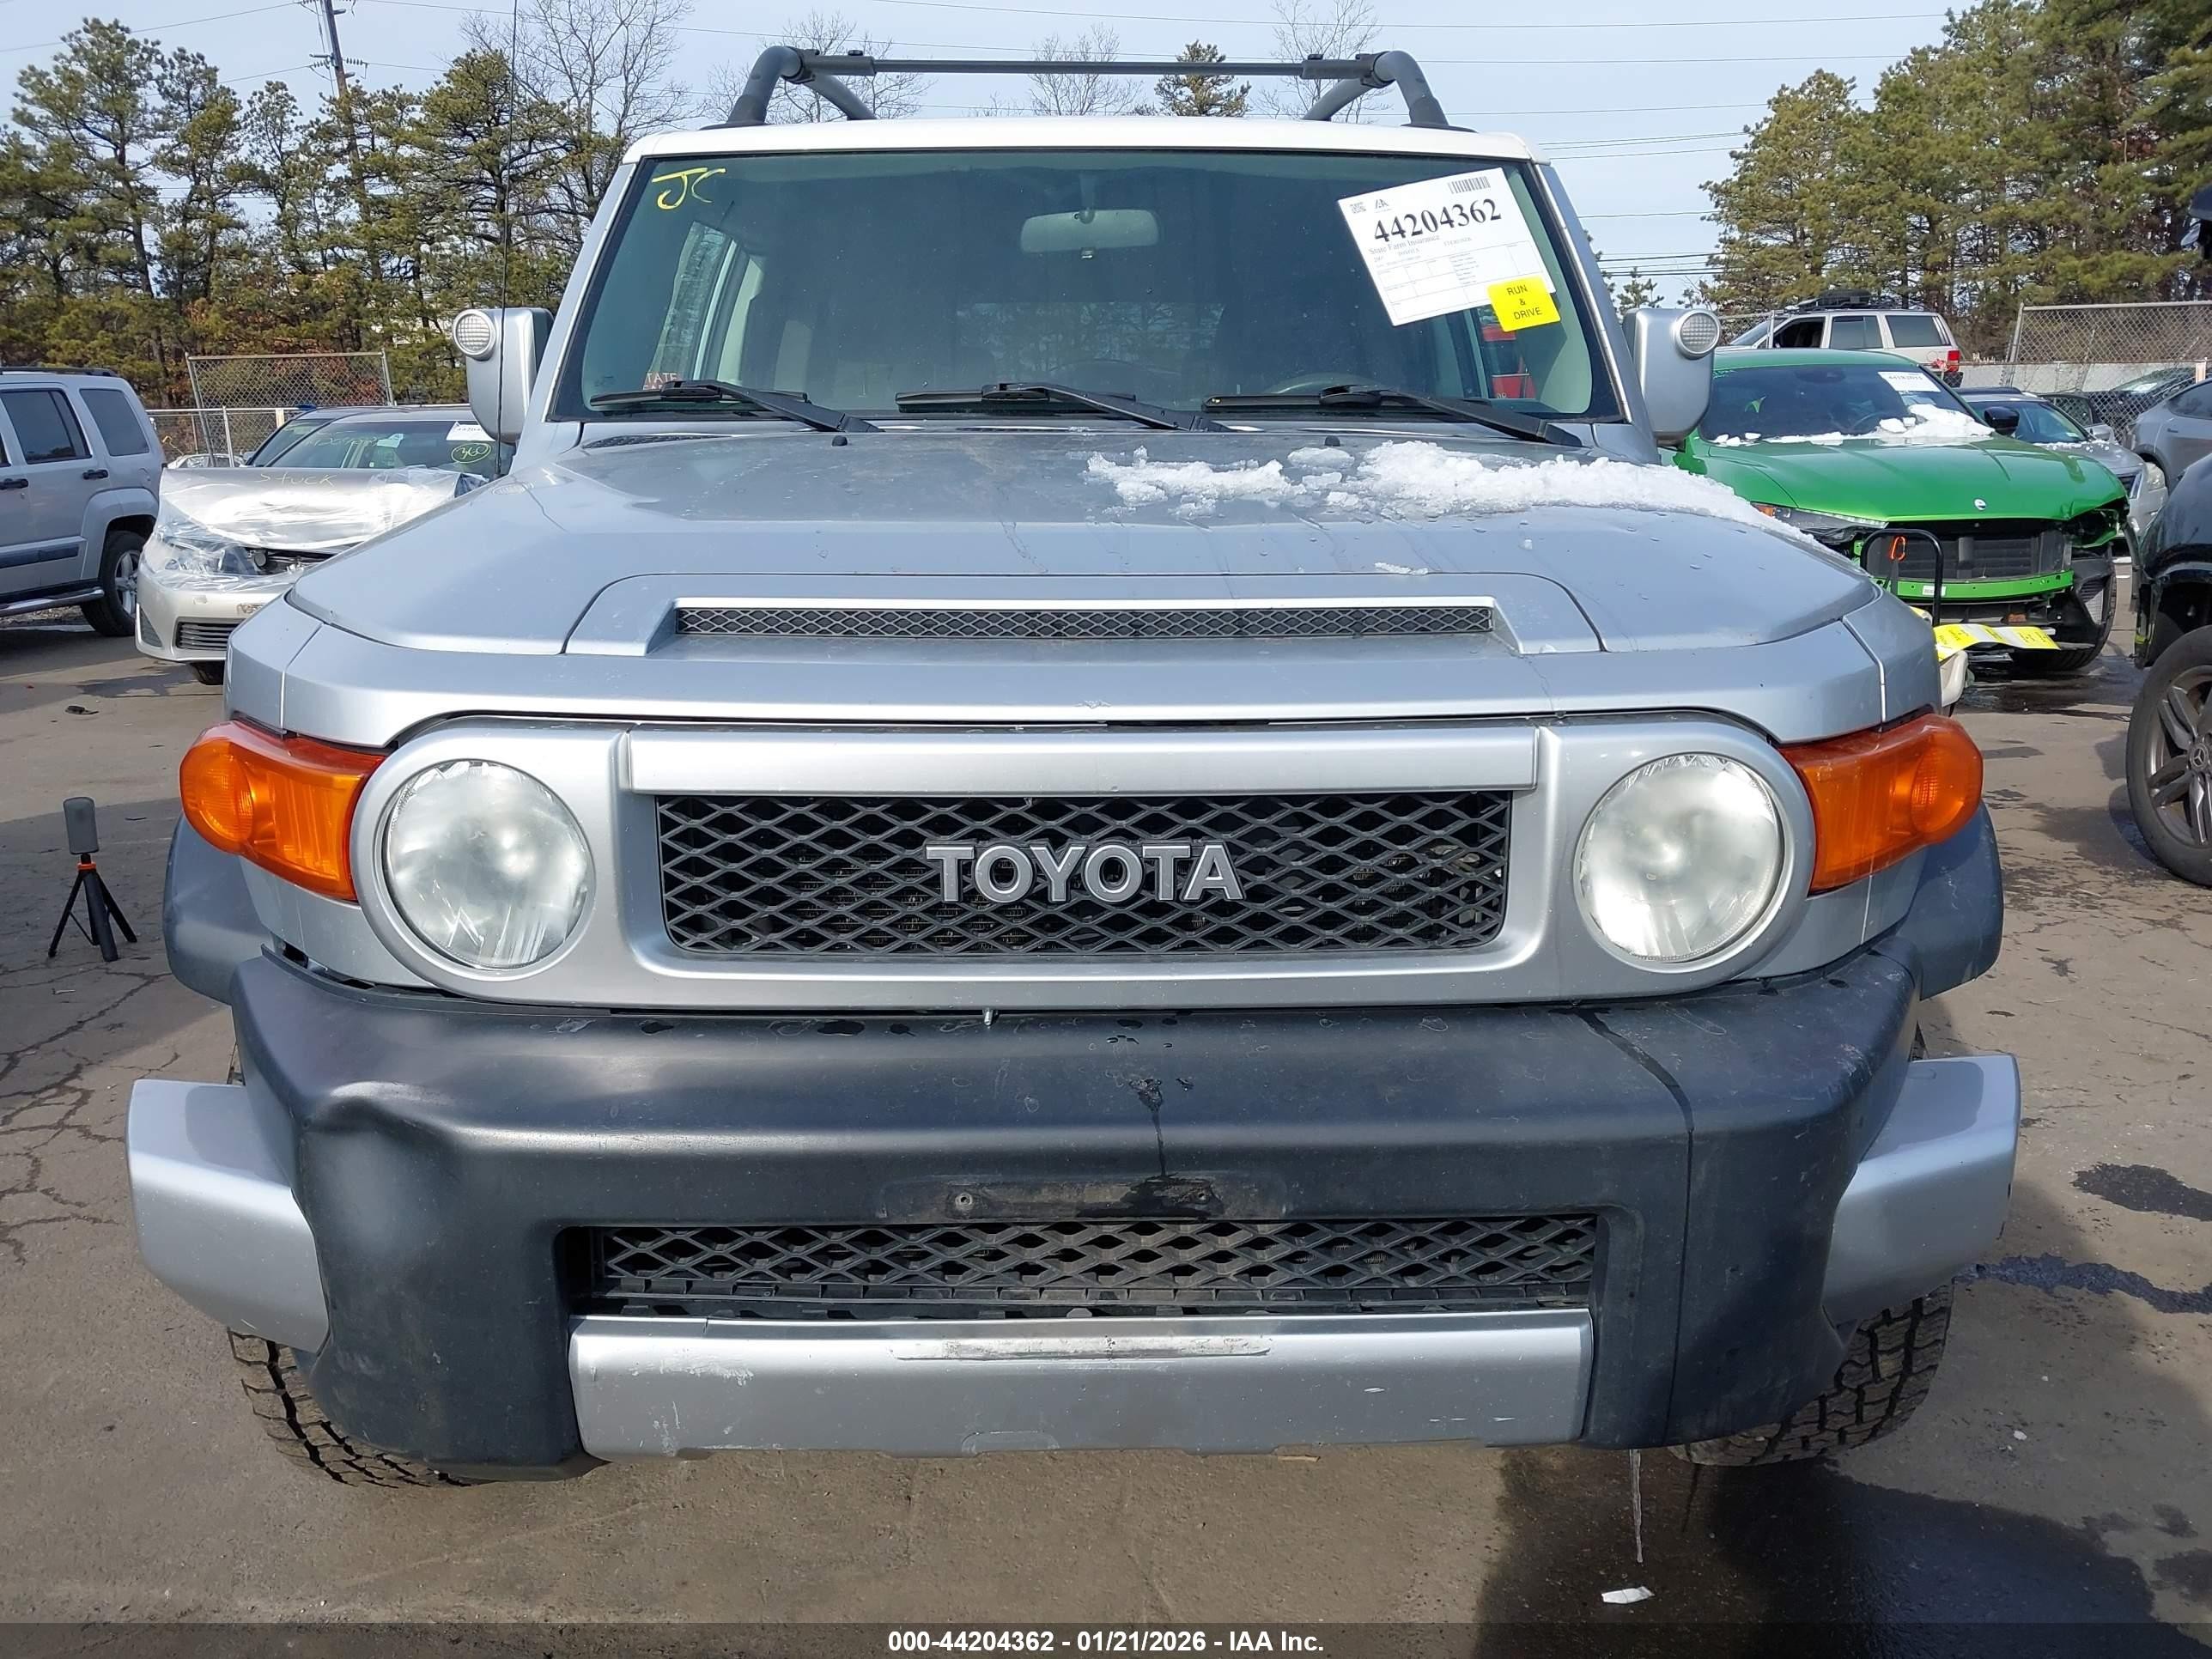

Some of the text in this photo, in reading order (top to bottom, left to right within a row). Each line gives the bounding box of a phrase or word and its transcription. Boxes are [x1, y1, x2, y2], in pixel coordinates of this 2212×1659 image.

[1374, 198, 1502, 243] 44204362
[1506, 284, 1528, 295] RUN
[1513, 307, 1543, 320] DRIVE
[925, 844, 1245, 903] TOYOTA
